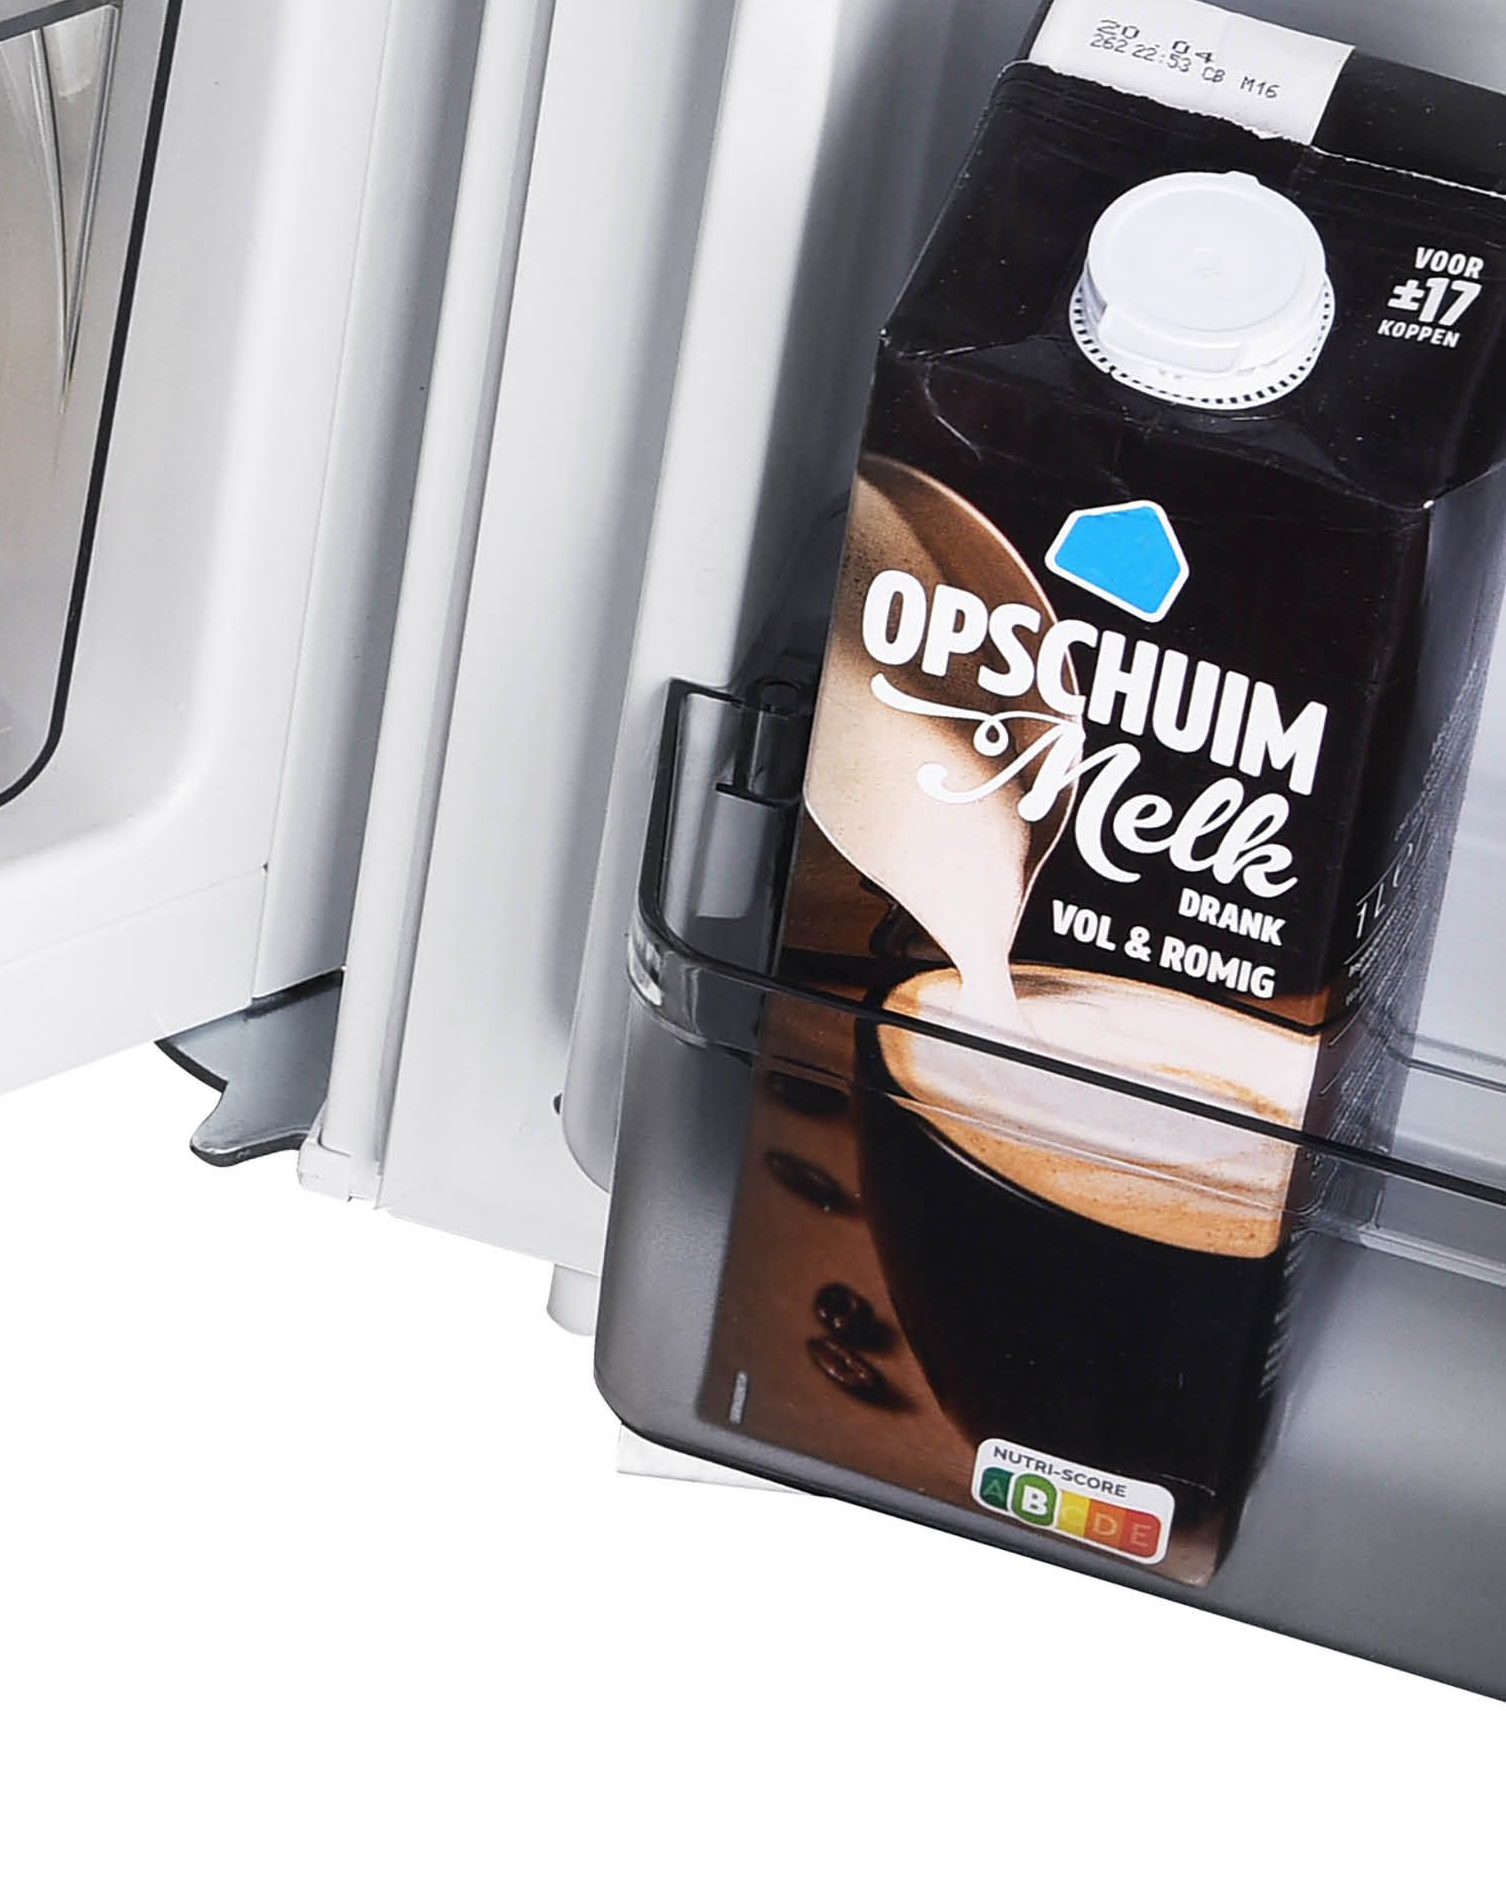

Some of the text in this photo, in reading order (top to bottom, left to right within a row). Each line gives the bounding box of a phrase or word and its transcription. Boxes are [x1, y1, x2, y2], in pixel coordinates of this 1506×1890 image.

[1090, 33, 1129, 54] 262
[1201, 66, 1227, 84] CB
[1239, 75, 1281, 99] M16
[1414, 246, 1485, 279] VOOR
[1387, 276, 1483, 326] ±17
[1377, 318, 1461, 349] KOPPEN
[861, 568, 1329, 797] OPSCHUIM
[916, 715, 1299, 899] Melk
[1177, 886, 1287, 947] DRANK
[1050, 898, 1276, 1000] VOL & ROMIG
[993, 1444, 1129, 1499] NUTRI-SCORE
[1021, 1484, 1049, 1516] B
[1093, 1512, 1119, 1537] D
[1130, 1522, 1154, 1548] E
